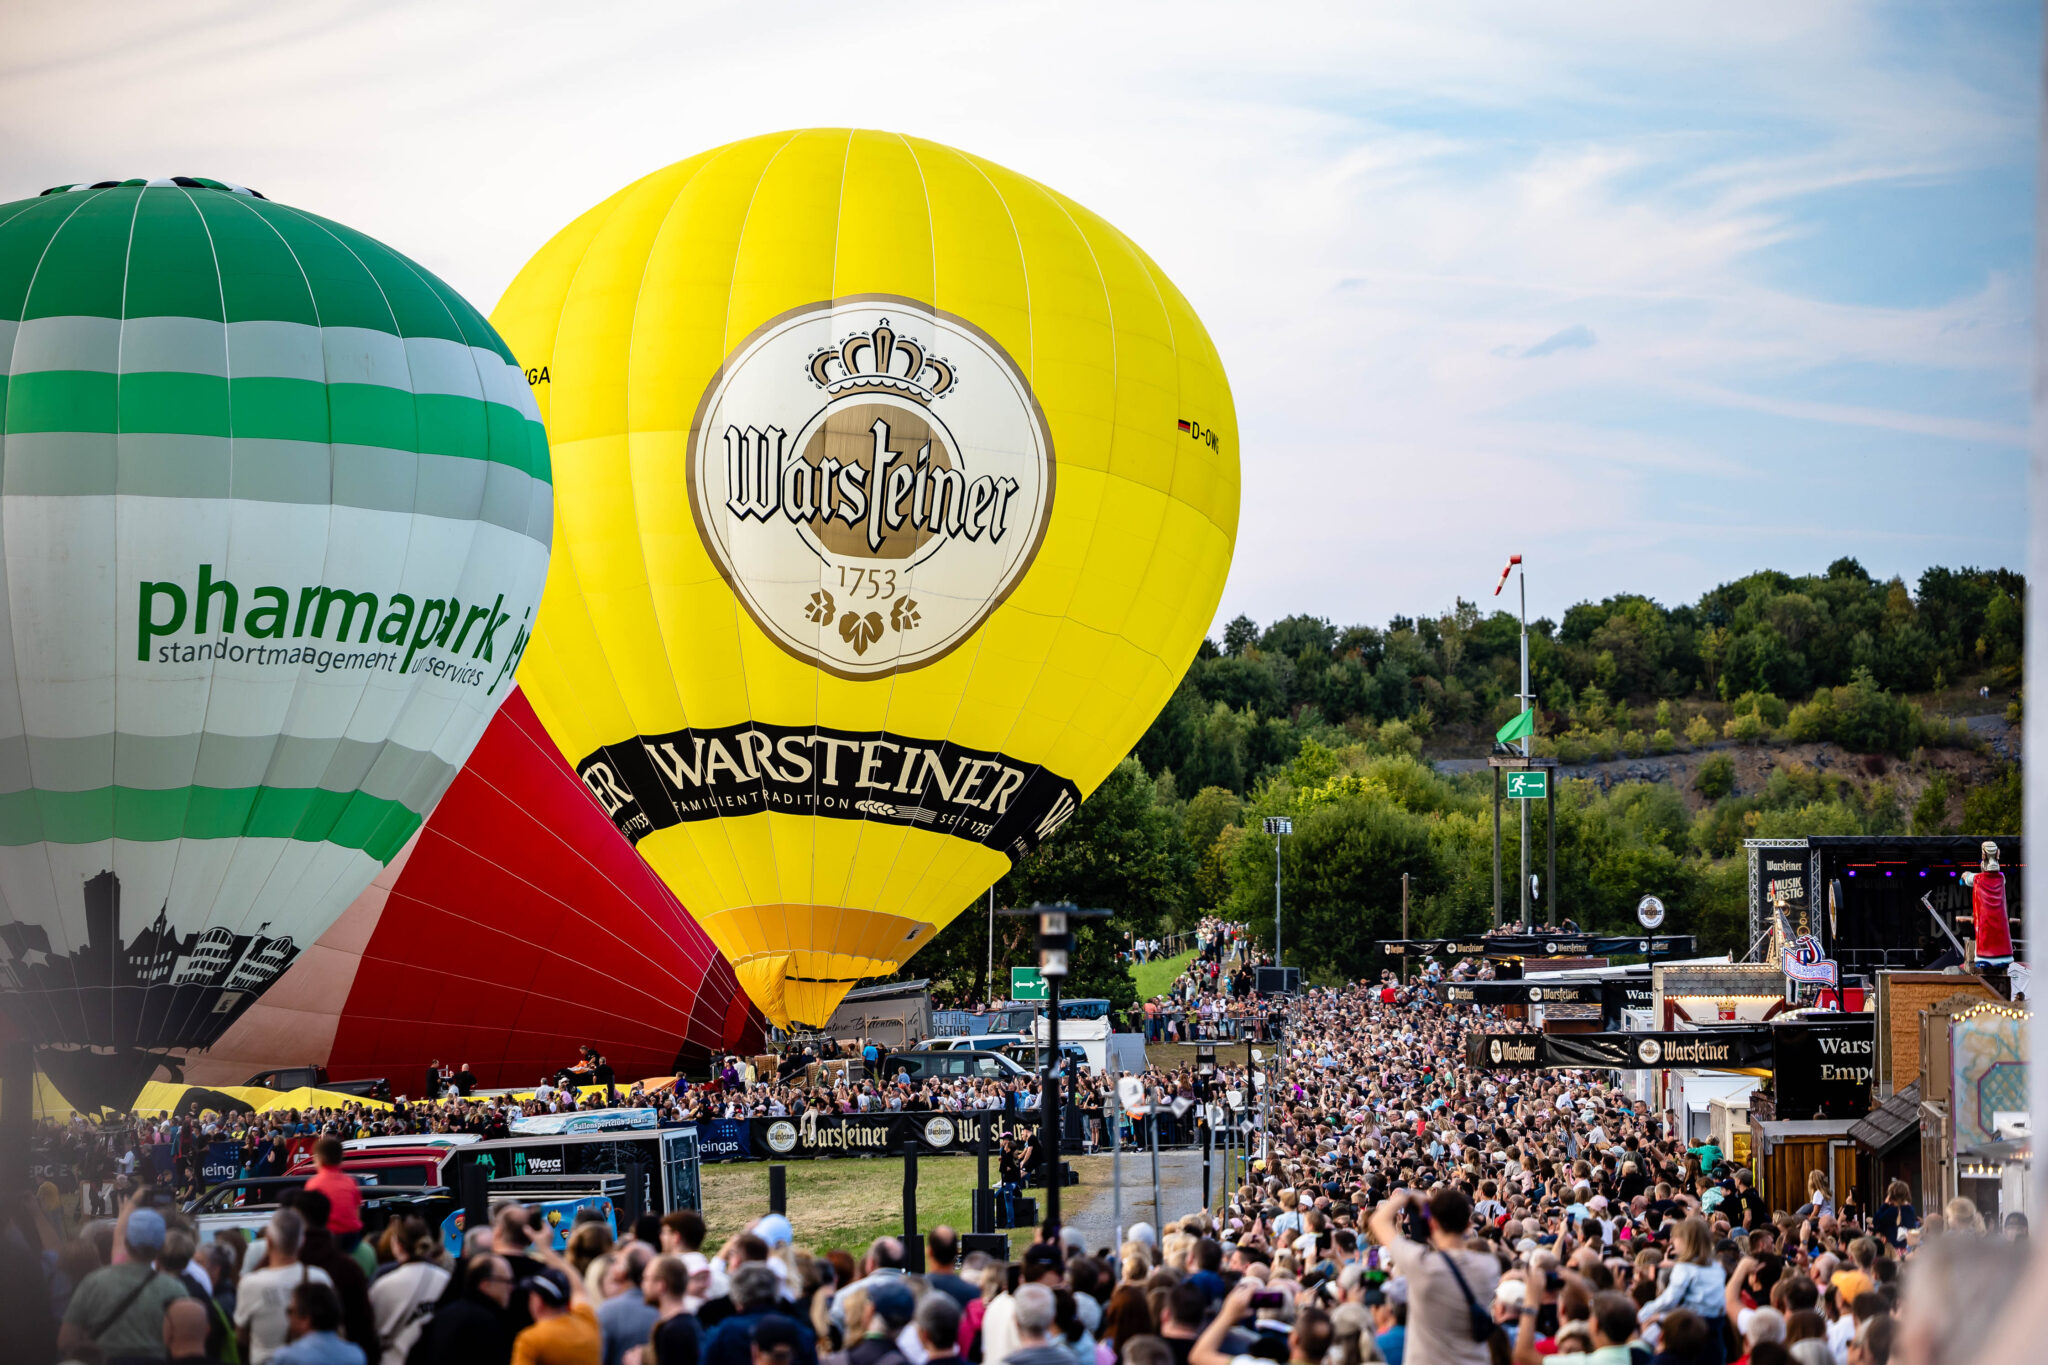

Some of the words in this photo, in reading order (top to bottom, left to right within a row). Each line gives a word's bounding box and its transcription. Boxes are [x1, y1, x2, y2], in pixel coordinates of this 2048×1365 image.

[525, 366, 551, 386] GA
[724, 417, 1020, 554] Warsteiner
[837, 565, 897, 600] 1753
[138, 564, 512, 674] pharmapark
[424, 656, 484, 687] services
[644, 730, 1025, 814] WARSTEINER
[672, 789, 849, 812] FAMILIENTRADITION
[939, 813, 969, 828] SEIT
[970, 820, 994, 837] 1753
[1766, 860, 1802, 872] Warsteiner
[1543, 987, 1579, 1002] Warsteiner
[1502, 1040, 1536, 1063] Warsteiner
[1664, 1039, 1729, 1064] Warsteiner
[1818, 1038, 1874, 1054] Wars
[202, 1163, 237, 1179] eing
[528, 1158, 561, 1169] Wera
